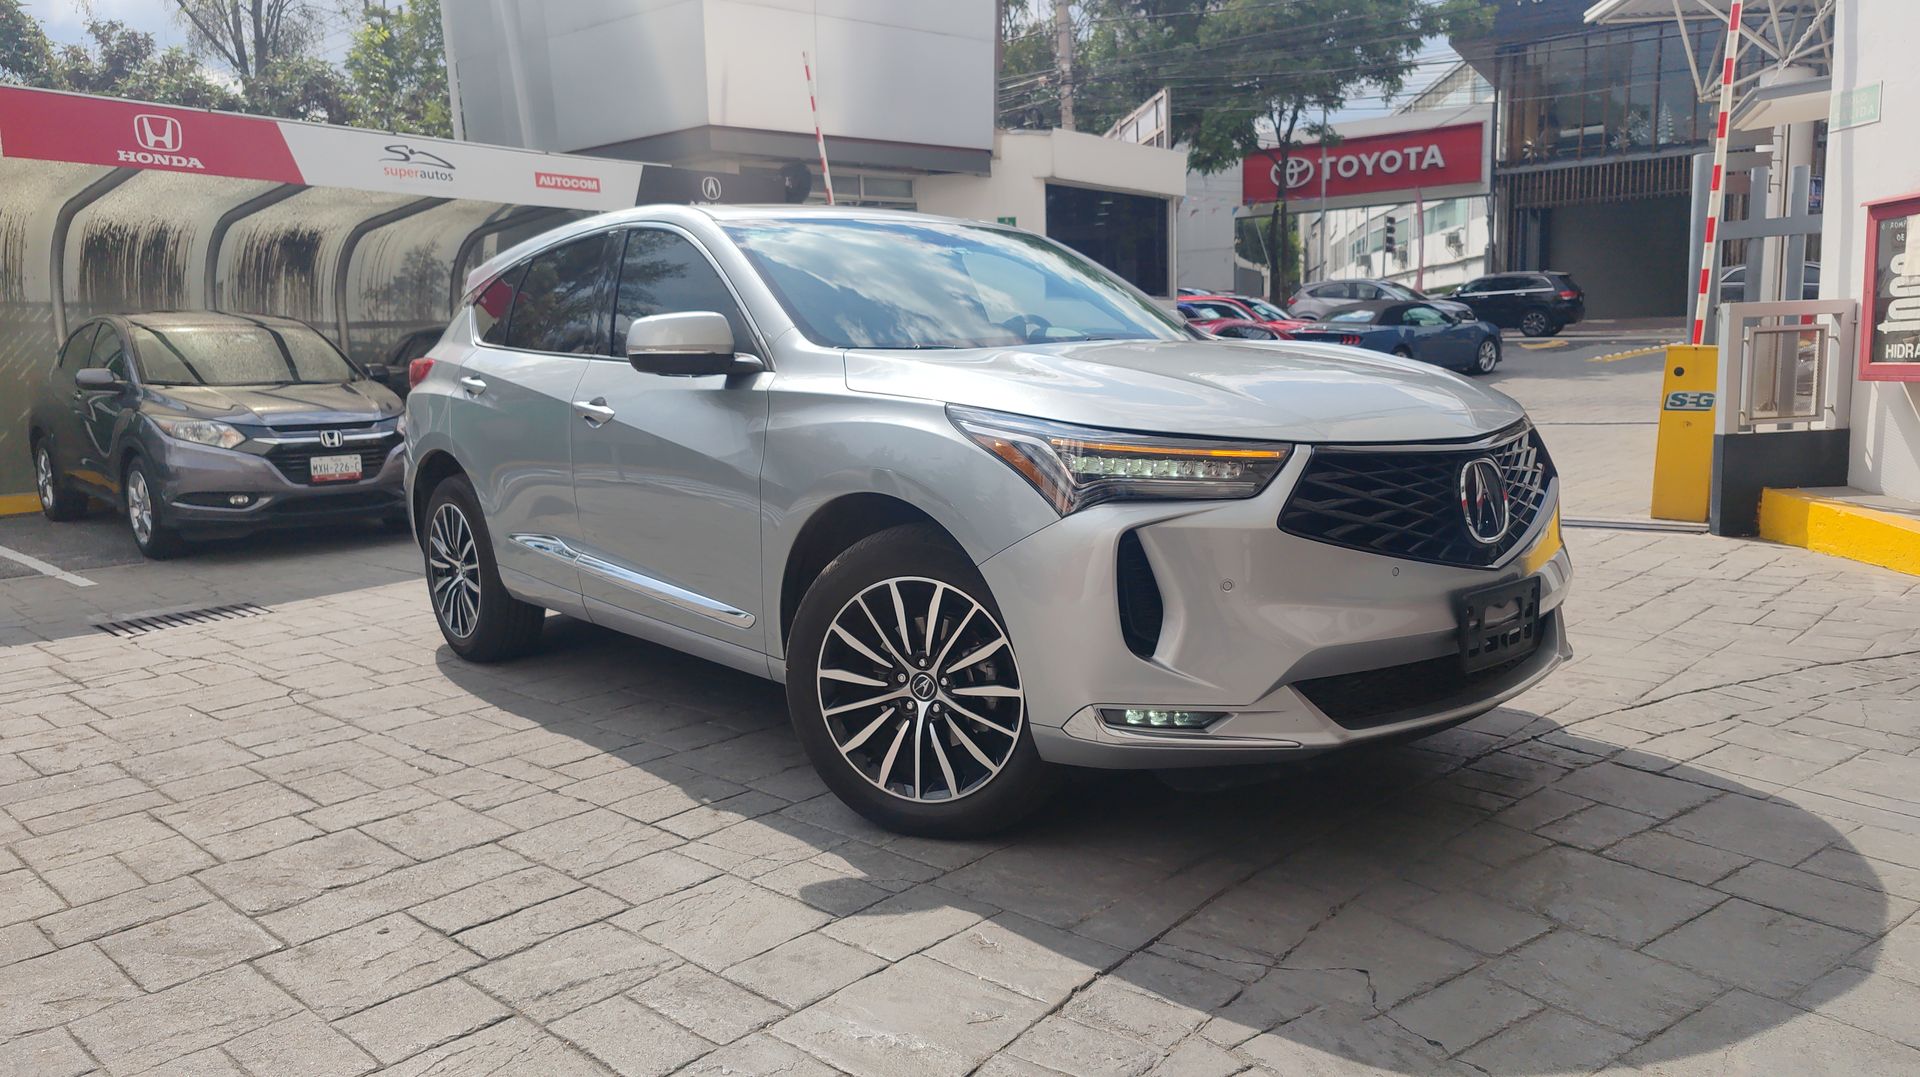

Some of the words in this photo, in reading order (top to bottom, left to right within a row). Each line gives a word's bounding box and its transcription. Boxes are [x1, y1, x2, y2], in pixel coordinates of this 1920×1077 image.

[117, 150, 205, 168] HONDA
[1318, 144, 1445, 180] TOYOTA
[384, 167, 453, 181] superautos
[539, 175, 598, 190] AUTOCOM
[1669, 393, 1715, 407] SEG
